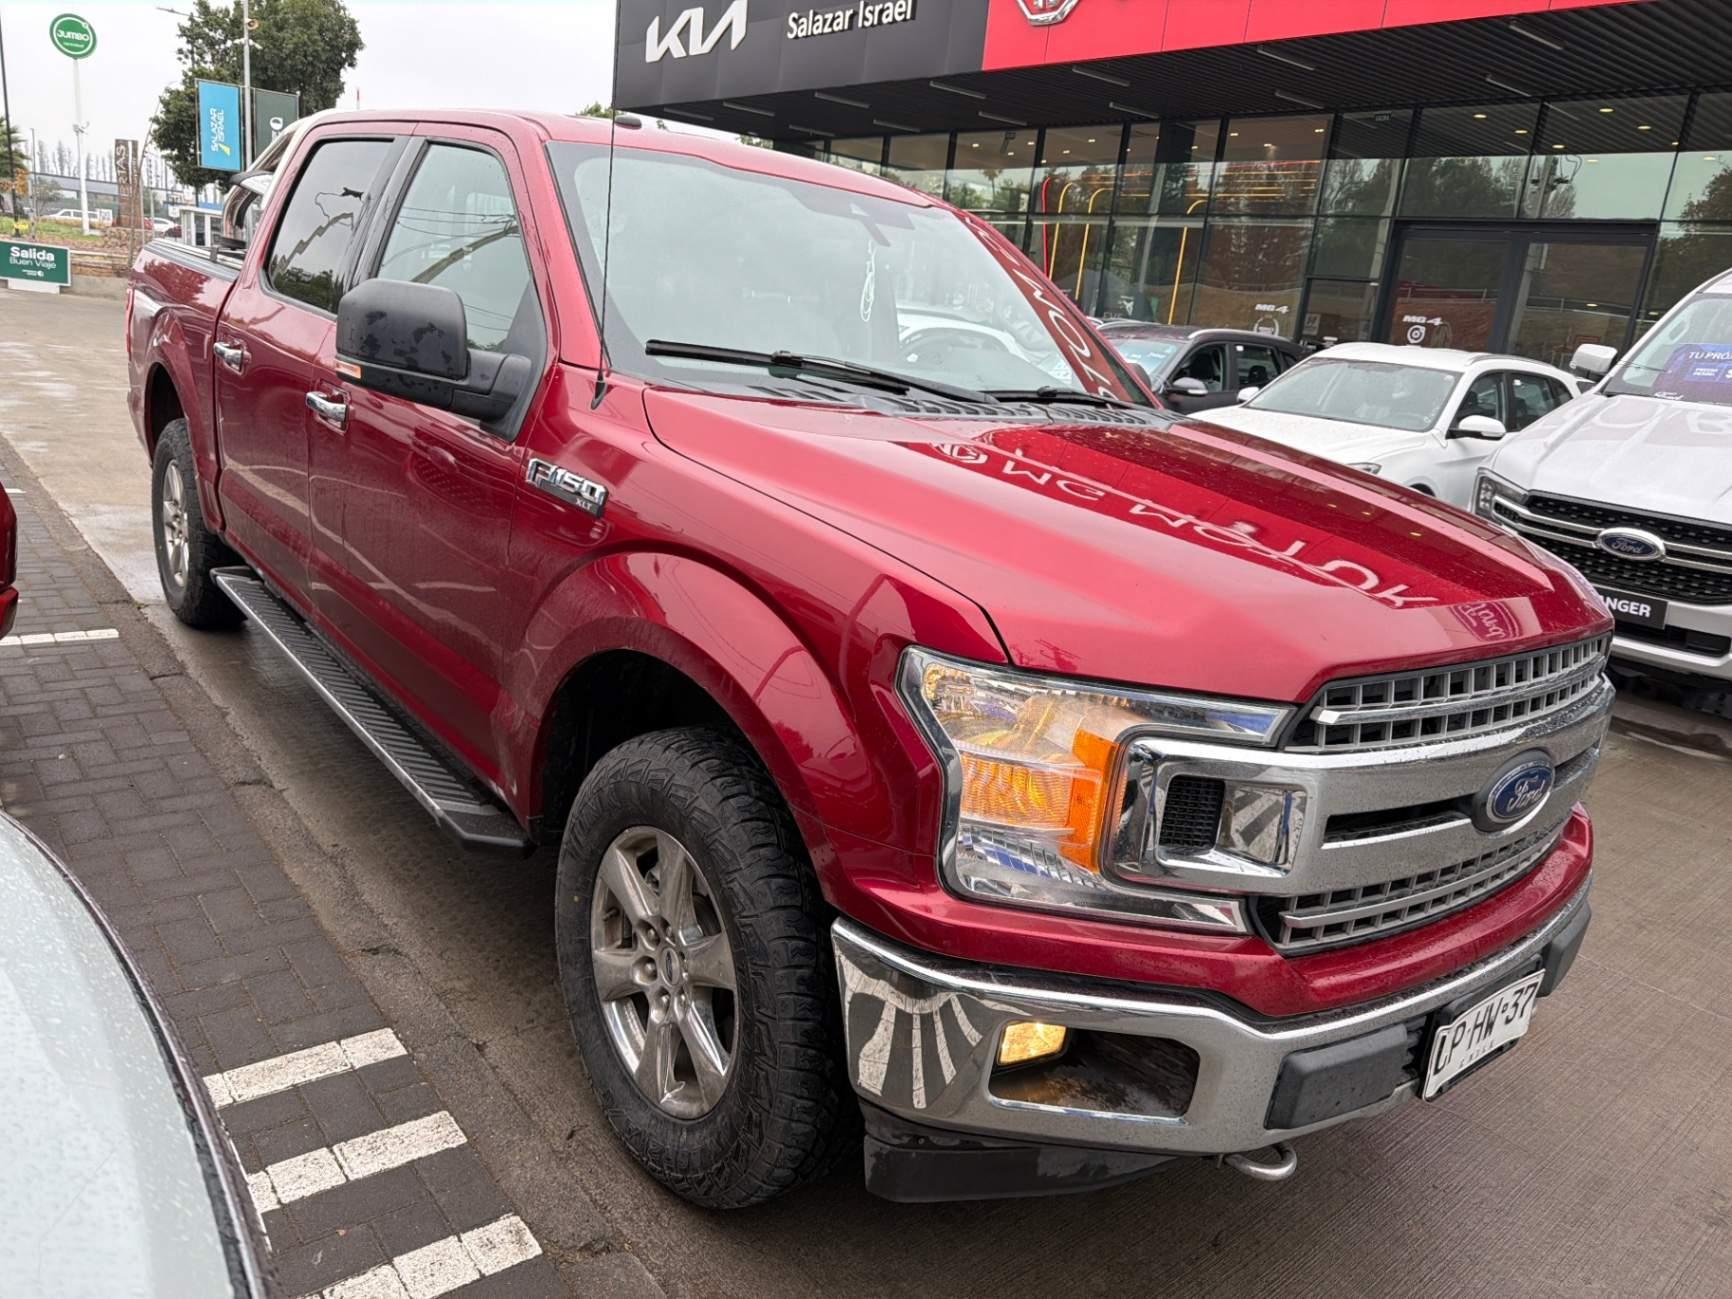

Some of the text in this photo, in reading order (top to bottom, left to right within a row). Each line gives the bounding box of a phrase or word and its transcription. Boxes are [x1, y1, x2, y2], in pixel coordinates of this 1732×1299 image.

[787, 0, 913, 39] Salazar Israel
[209, 107, 219, 152] SALAZAR
[217, 109, 225, 142] ISRAEL
[10, 246, 55, 261] Salida
[576, 498, 593, 511] XLT
[1506, 773, 1547, 812] Ford
